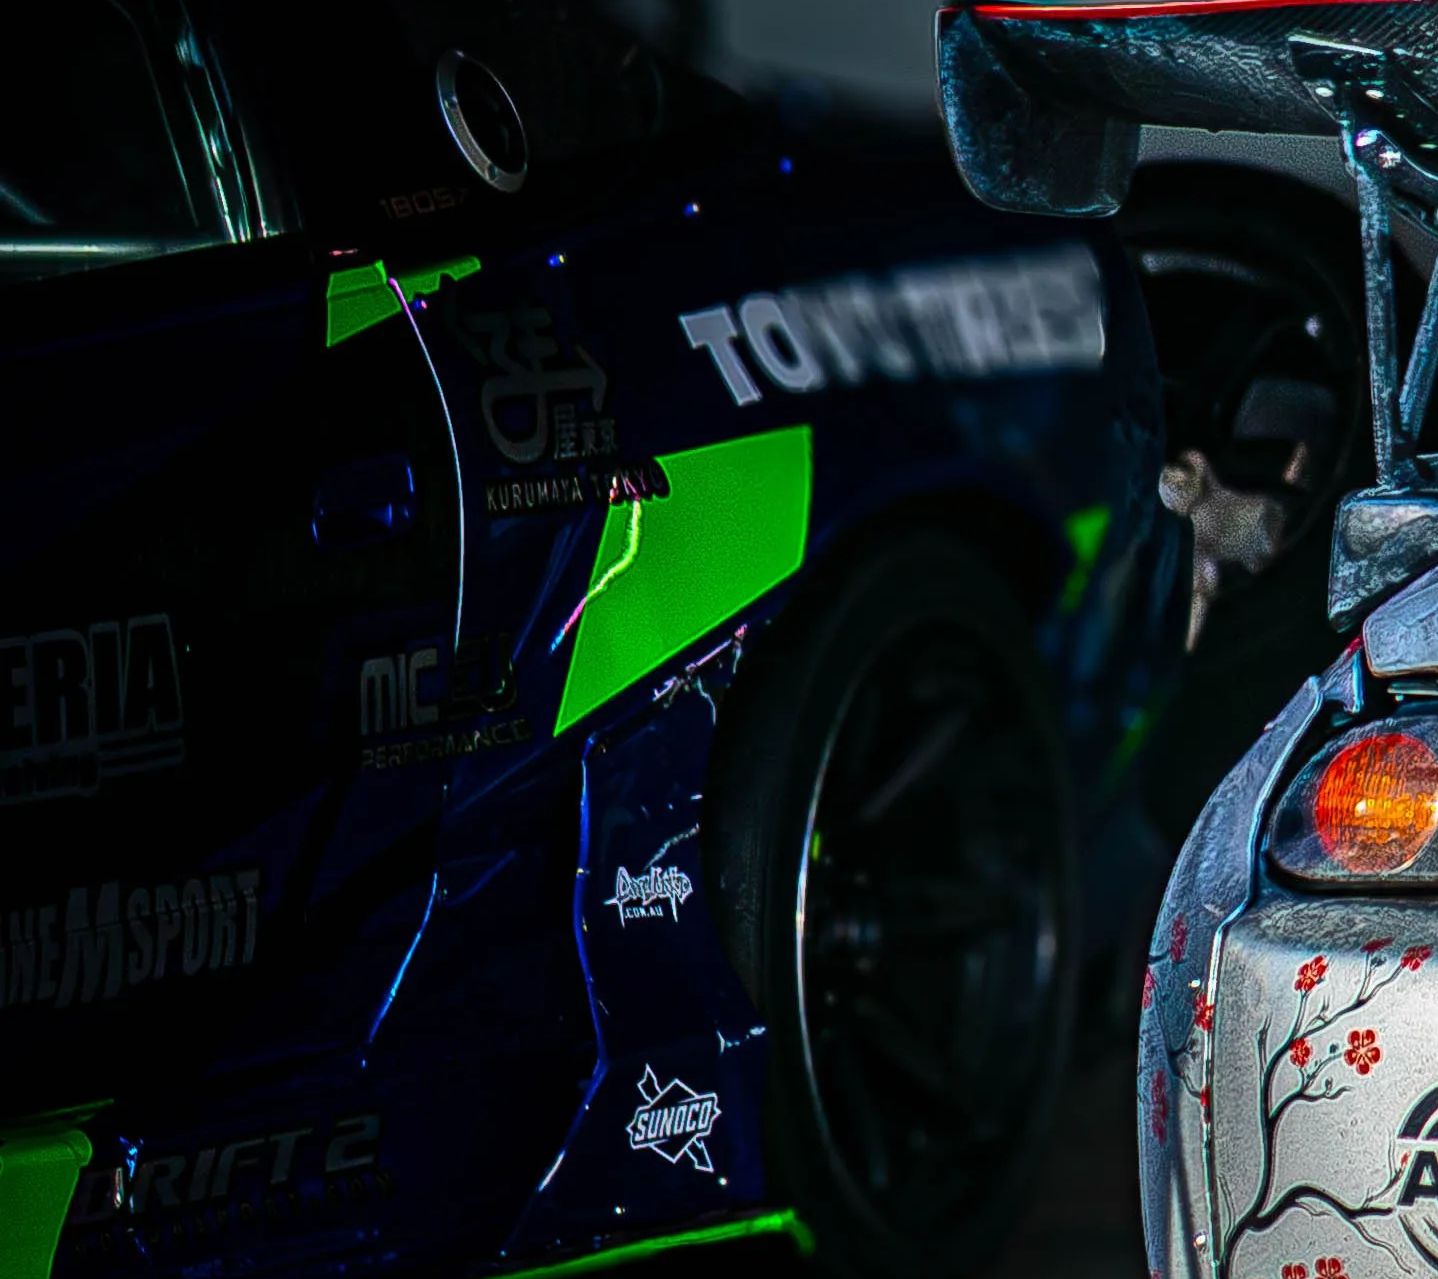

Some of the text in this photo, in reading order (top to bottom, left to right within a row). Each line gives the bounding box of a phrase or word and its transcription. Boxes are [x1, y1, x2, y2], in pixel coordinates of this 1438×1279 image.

[485, 474, 584, 512] KURUMAYA
[634, 1100, 713, 1142] SUNOCO
[67, 1125, 314, 1226] DRIFT
[322, 1112, 382, 1174] 2
